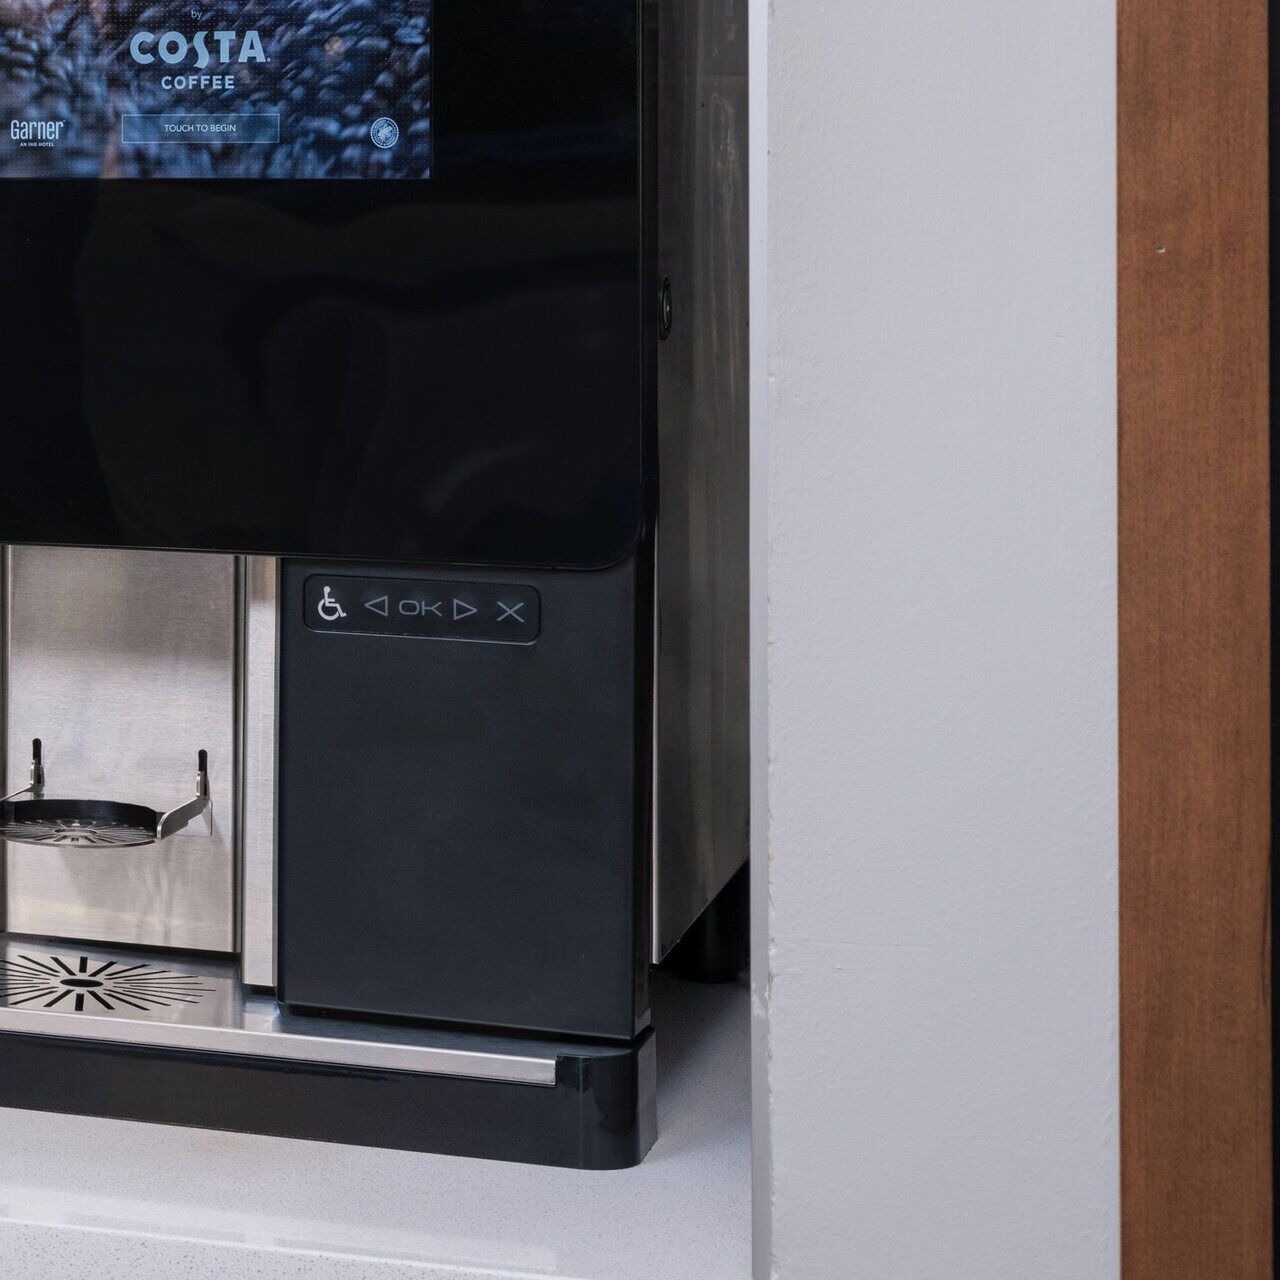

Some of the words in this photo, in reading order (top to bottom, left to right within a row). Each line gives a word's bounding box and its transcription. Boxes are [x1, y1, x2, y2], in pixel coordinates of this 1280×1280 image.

[191, 9, 203, 20] by
[129, 31, 266, 69] COSTA
[161, 75, 235, 90] COFFEE
[10, 120, 64, 140] Garner
[164, 124, 193, 133] TOUCH
[194, 124, 208, 133] TO
[210, 124, 236, 133] BEGIN
[398, 600, 443, 617] OK
